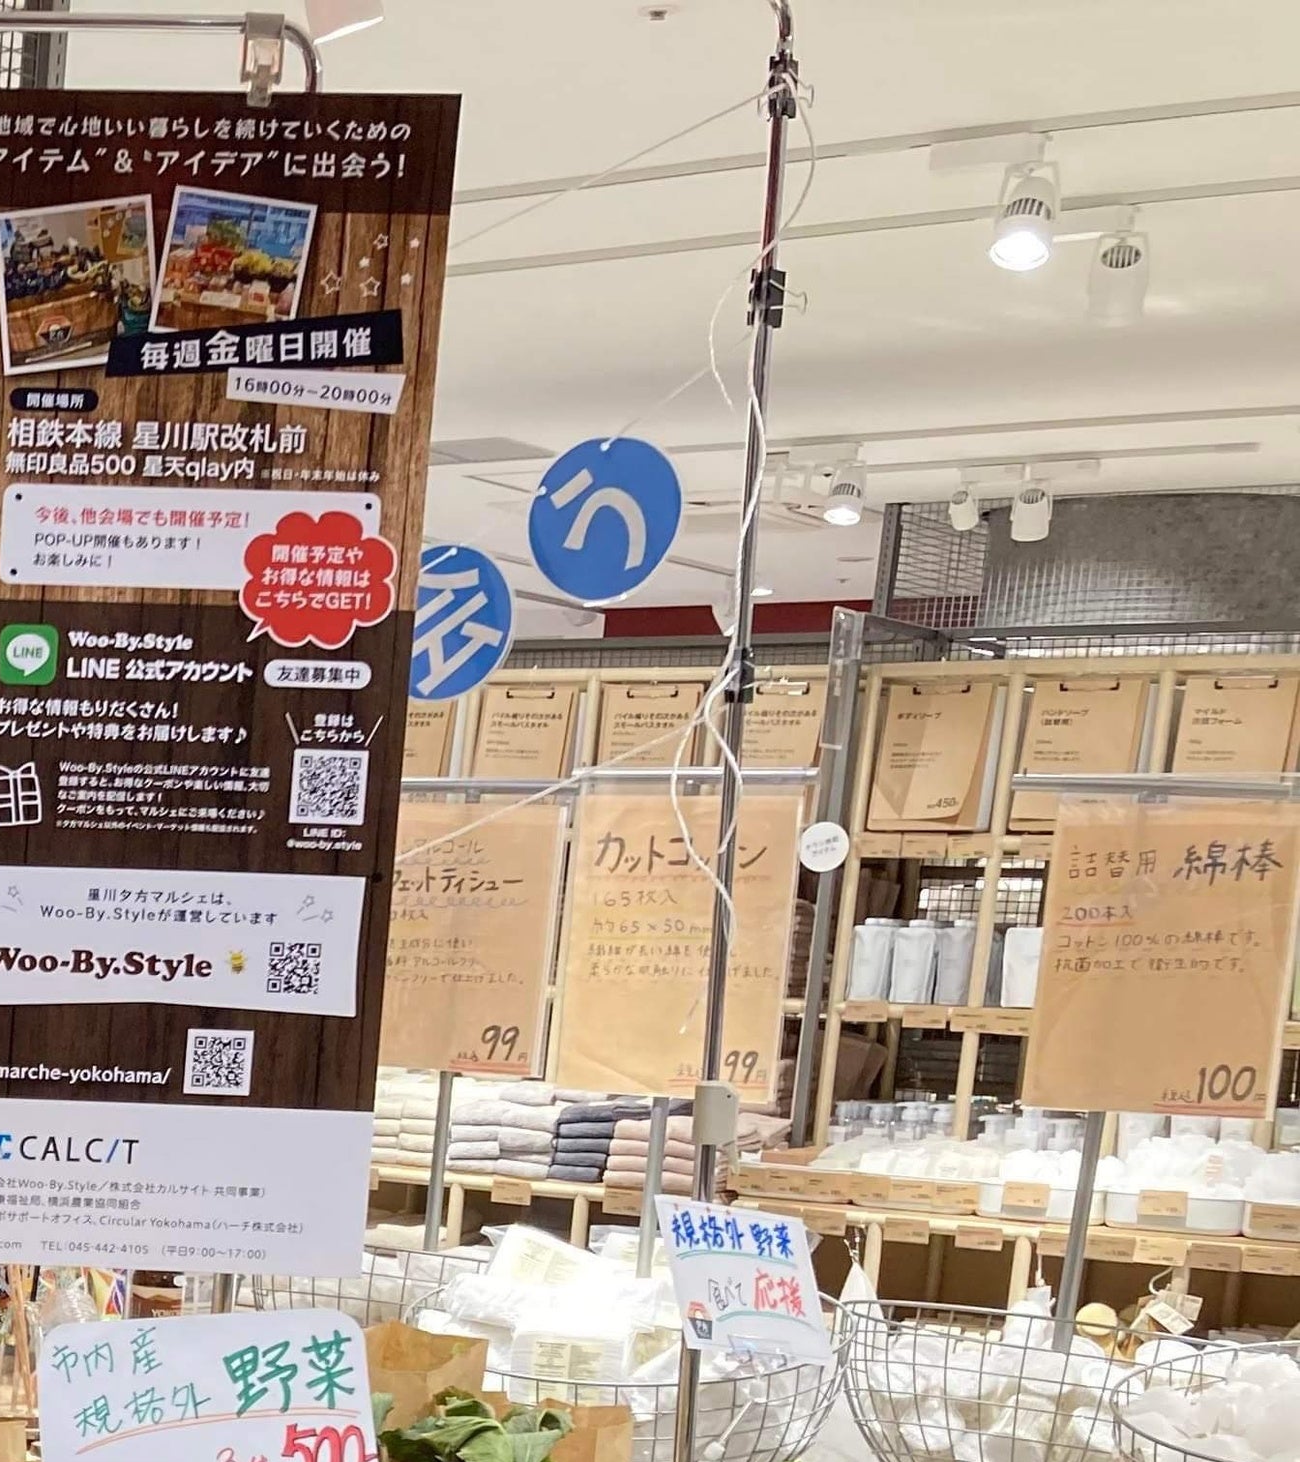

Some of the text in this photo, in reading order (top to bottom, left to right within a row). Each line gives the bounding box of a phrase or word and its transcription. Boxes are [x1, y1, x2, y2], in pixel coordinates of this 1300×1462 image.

[141, 328, 373, 370] 毎週金曜日開催
[26, 392, 84, 410] 開催場所
[6, 416, 308, 454] 相鉄本線 星川駅改札前
[5, 450, 136, 476] 無印良品500
[142, 456, 255, 482] 星天qlay内
[270, 545, 365, 565] 開催予定や
[261, 566, 371, 588] お得な情報は
[254, 590, 372, 612] こちらでGET!
[12, 645, 44, 659] LINE
[67, 631, 194, 652] Woo-By.Style
[66, 657, 254, 684] LINE 公式アカウント
[276, 665, 362, 683] 友達募集中
[299, 727, 366, 744] こちらから
[1069, 838, 1284, 886] 詰替用 綿棒
[222, 1329, 356, 1418] 野菜
[74, 1381, 211, 1438] 規格外
